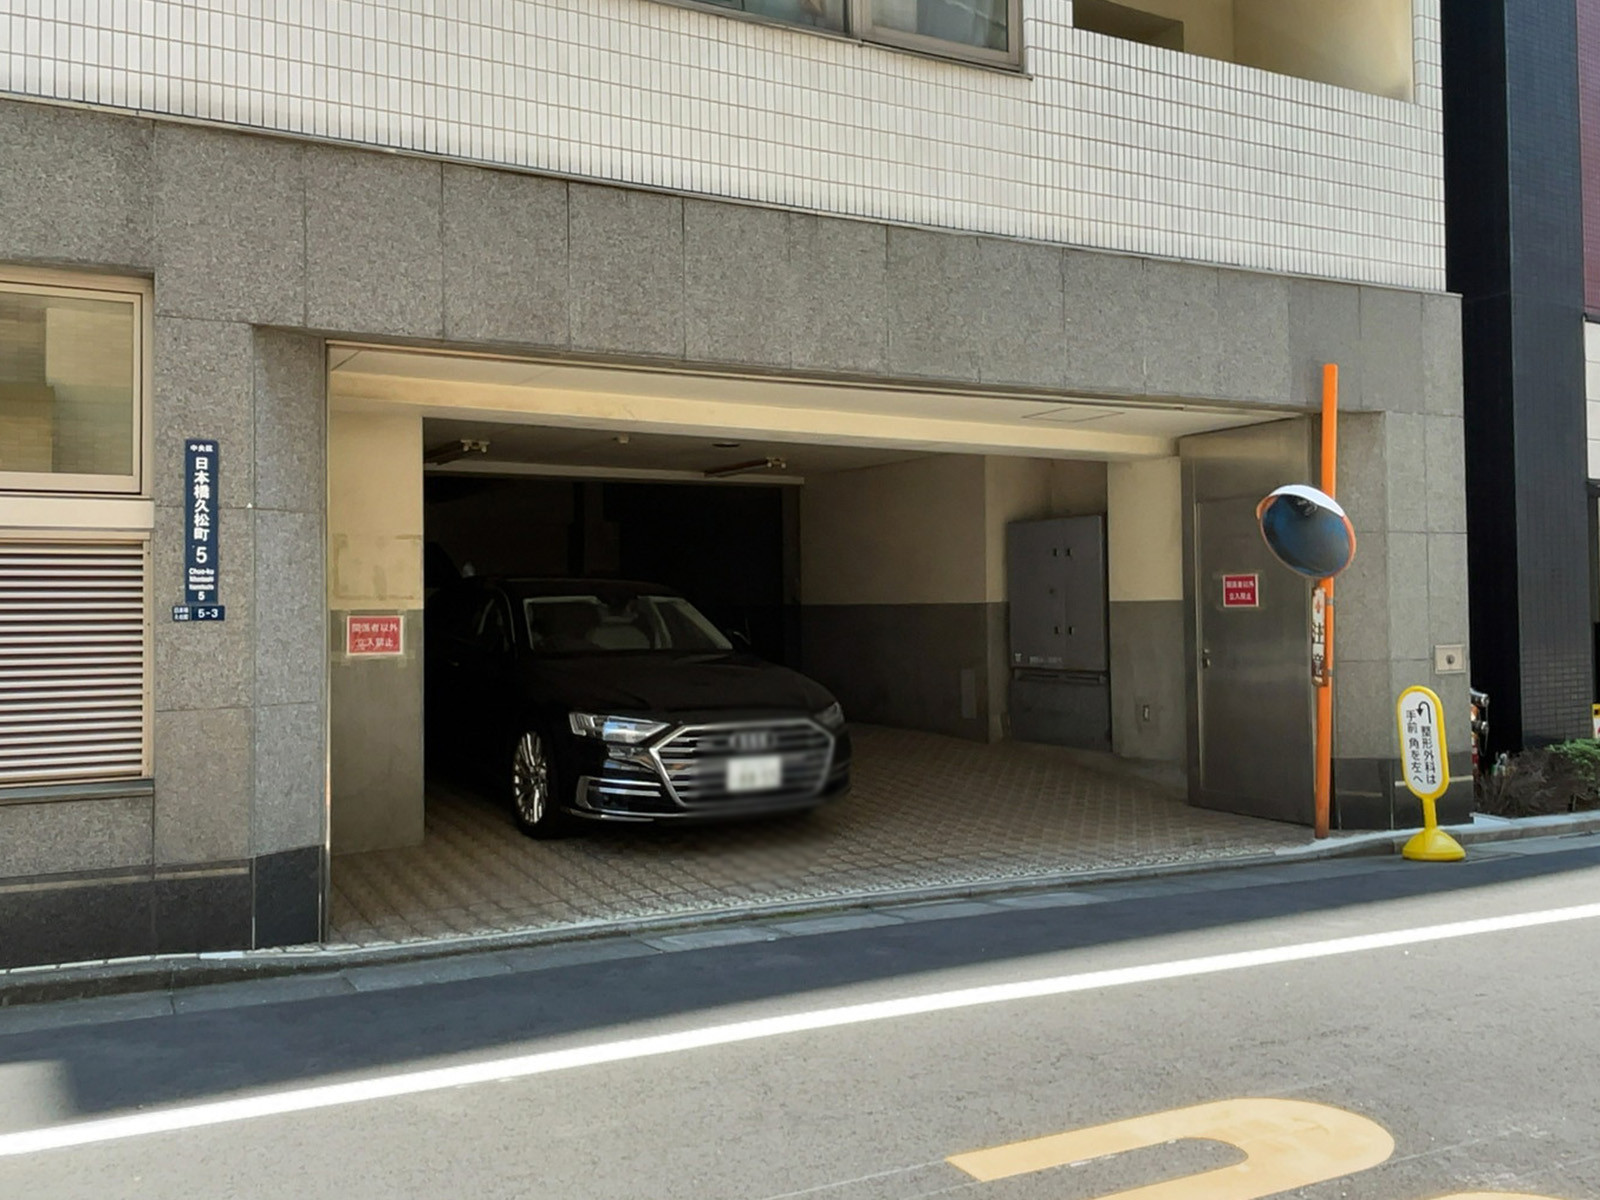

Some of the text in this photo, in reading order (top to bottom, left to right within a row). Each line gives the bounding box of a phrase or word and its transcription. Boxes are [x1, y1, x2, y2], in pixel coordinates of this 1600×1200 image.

[193, 456, 210, 542] 日本橋久松町
[195, 546, 208, 564] 5
[198, 591, 205, 601] 5
[198, 608, 219, 618] 5-3
[1421, 725, 1436, 785] 整形外科は
